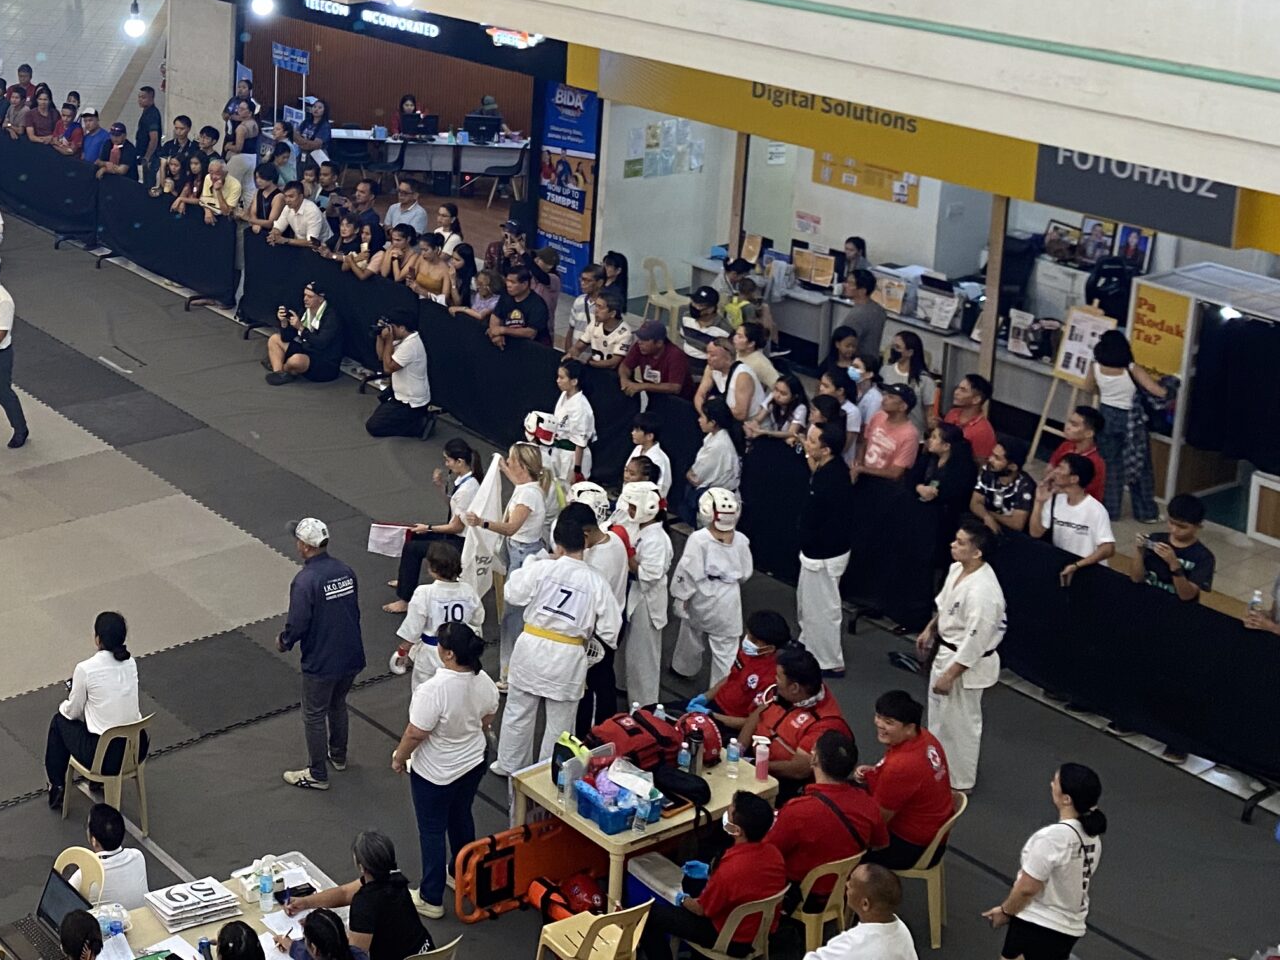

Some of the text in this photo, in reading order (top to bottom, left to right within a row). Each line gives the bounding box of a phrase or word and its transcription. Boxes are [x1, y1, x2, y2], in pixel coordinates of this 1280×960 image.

[362, 9, 439, 38] INCORPORATED
[556, 89, 584, 111] BIDA
[752, 81, 918, 134] Digital Solutions
[1137, 297, 1157, 313] Pa
[1134, 312, 1185, 339] Kodak
[557, 588, 573, 609] 7
[443, 603, 464, 623] 10
